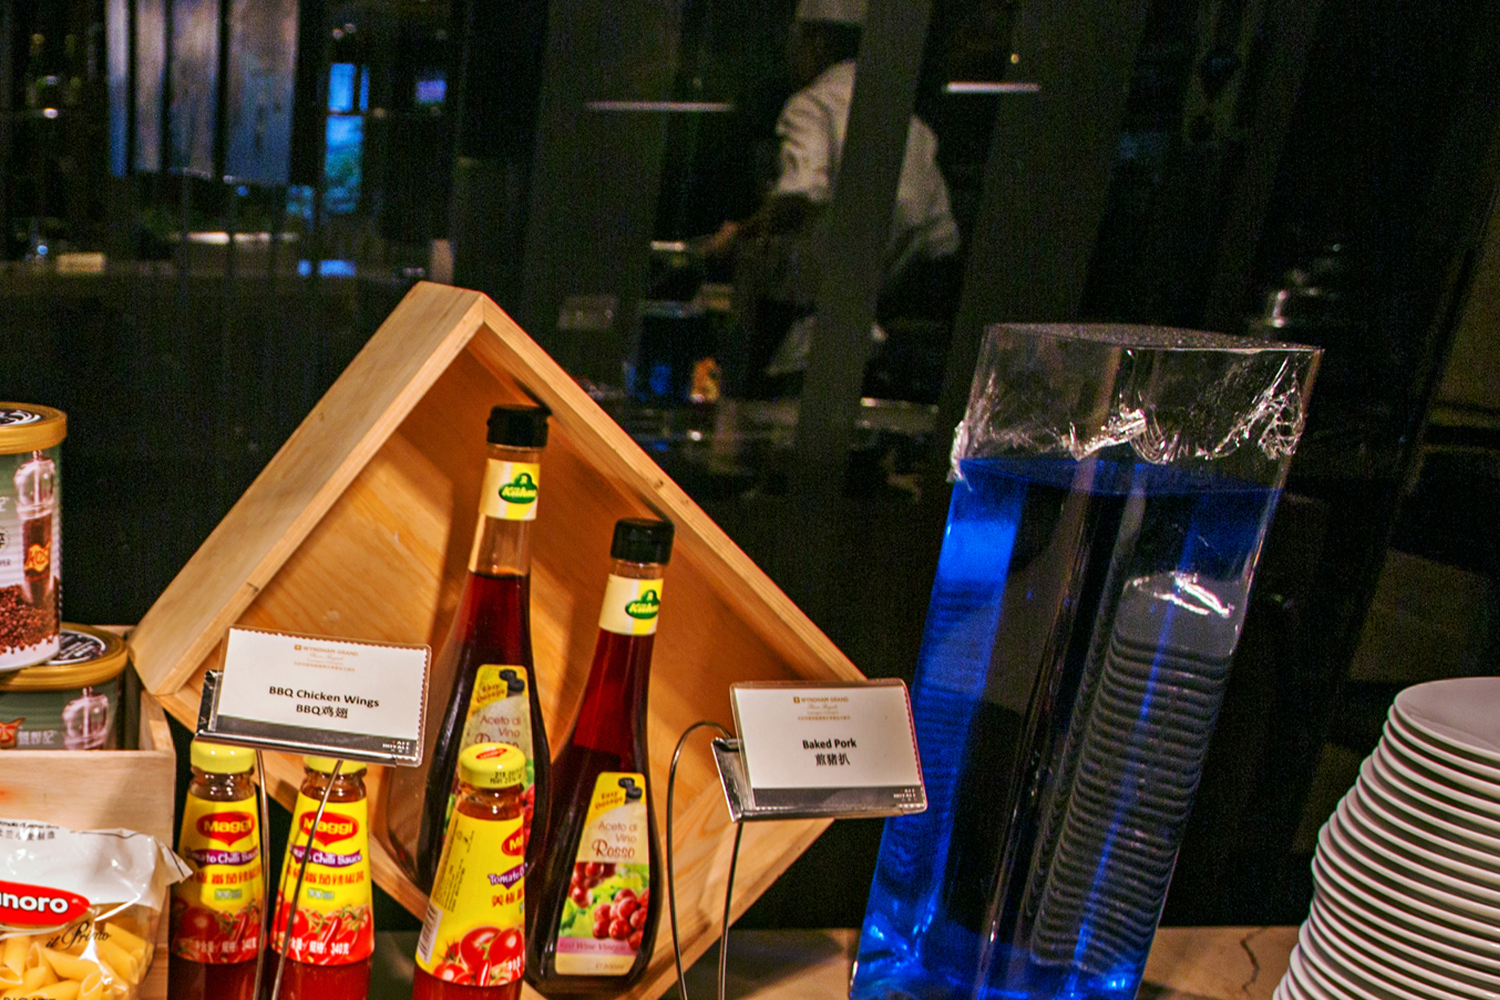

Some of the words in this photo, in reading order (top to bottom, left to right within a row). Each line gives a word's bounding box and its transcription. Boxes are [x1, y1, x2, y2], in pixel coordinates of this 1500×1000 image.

[269, 685, 294, 699] BBQ
[296, 689, 341, 702] Chicken
[344, 695, 380, 709] Wings
[481, 715, 509, 726] Aceto
[498, 727, 521, 738] Vino
[802, 738, 832, 749] Baked
[834, 737, 857, 748] Pork
[815, 752, 851, 766] 煎猪扒
[203, 819, 252, 834] Maggi
[303, 817, 353, 835] Maggi
[598, 821, 626, 831] Aceto
[615, 833, 637, 843] Vino
[591, 838, 636, 858] Rosso
[218, 852, 240, 864] Chilli
[313, 851, 336, 864] Chilli
[337, 854, 363, 866] Sauce
[487, 869, 521, 886] Tomato
